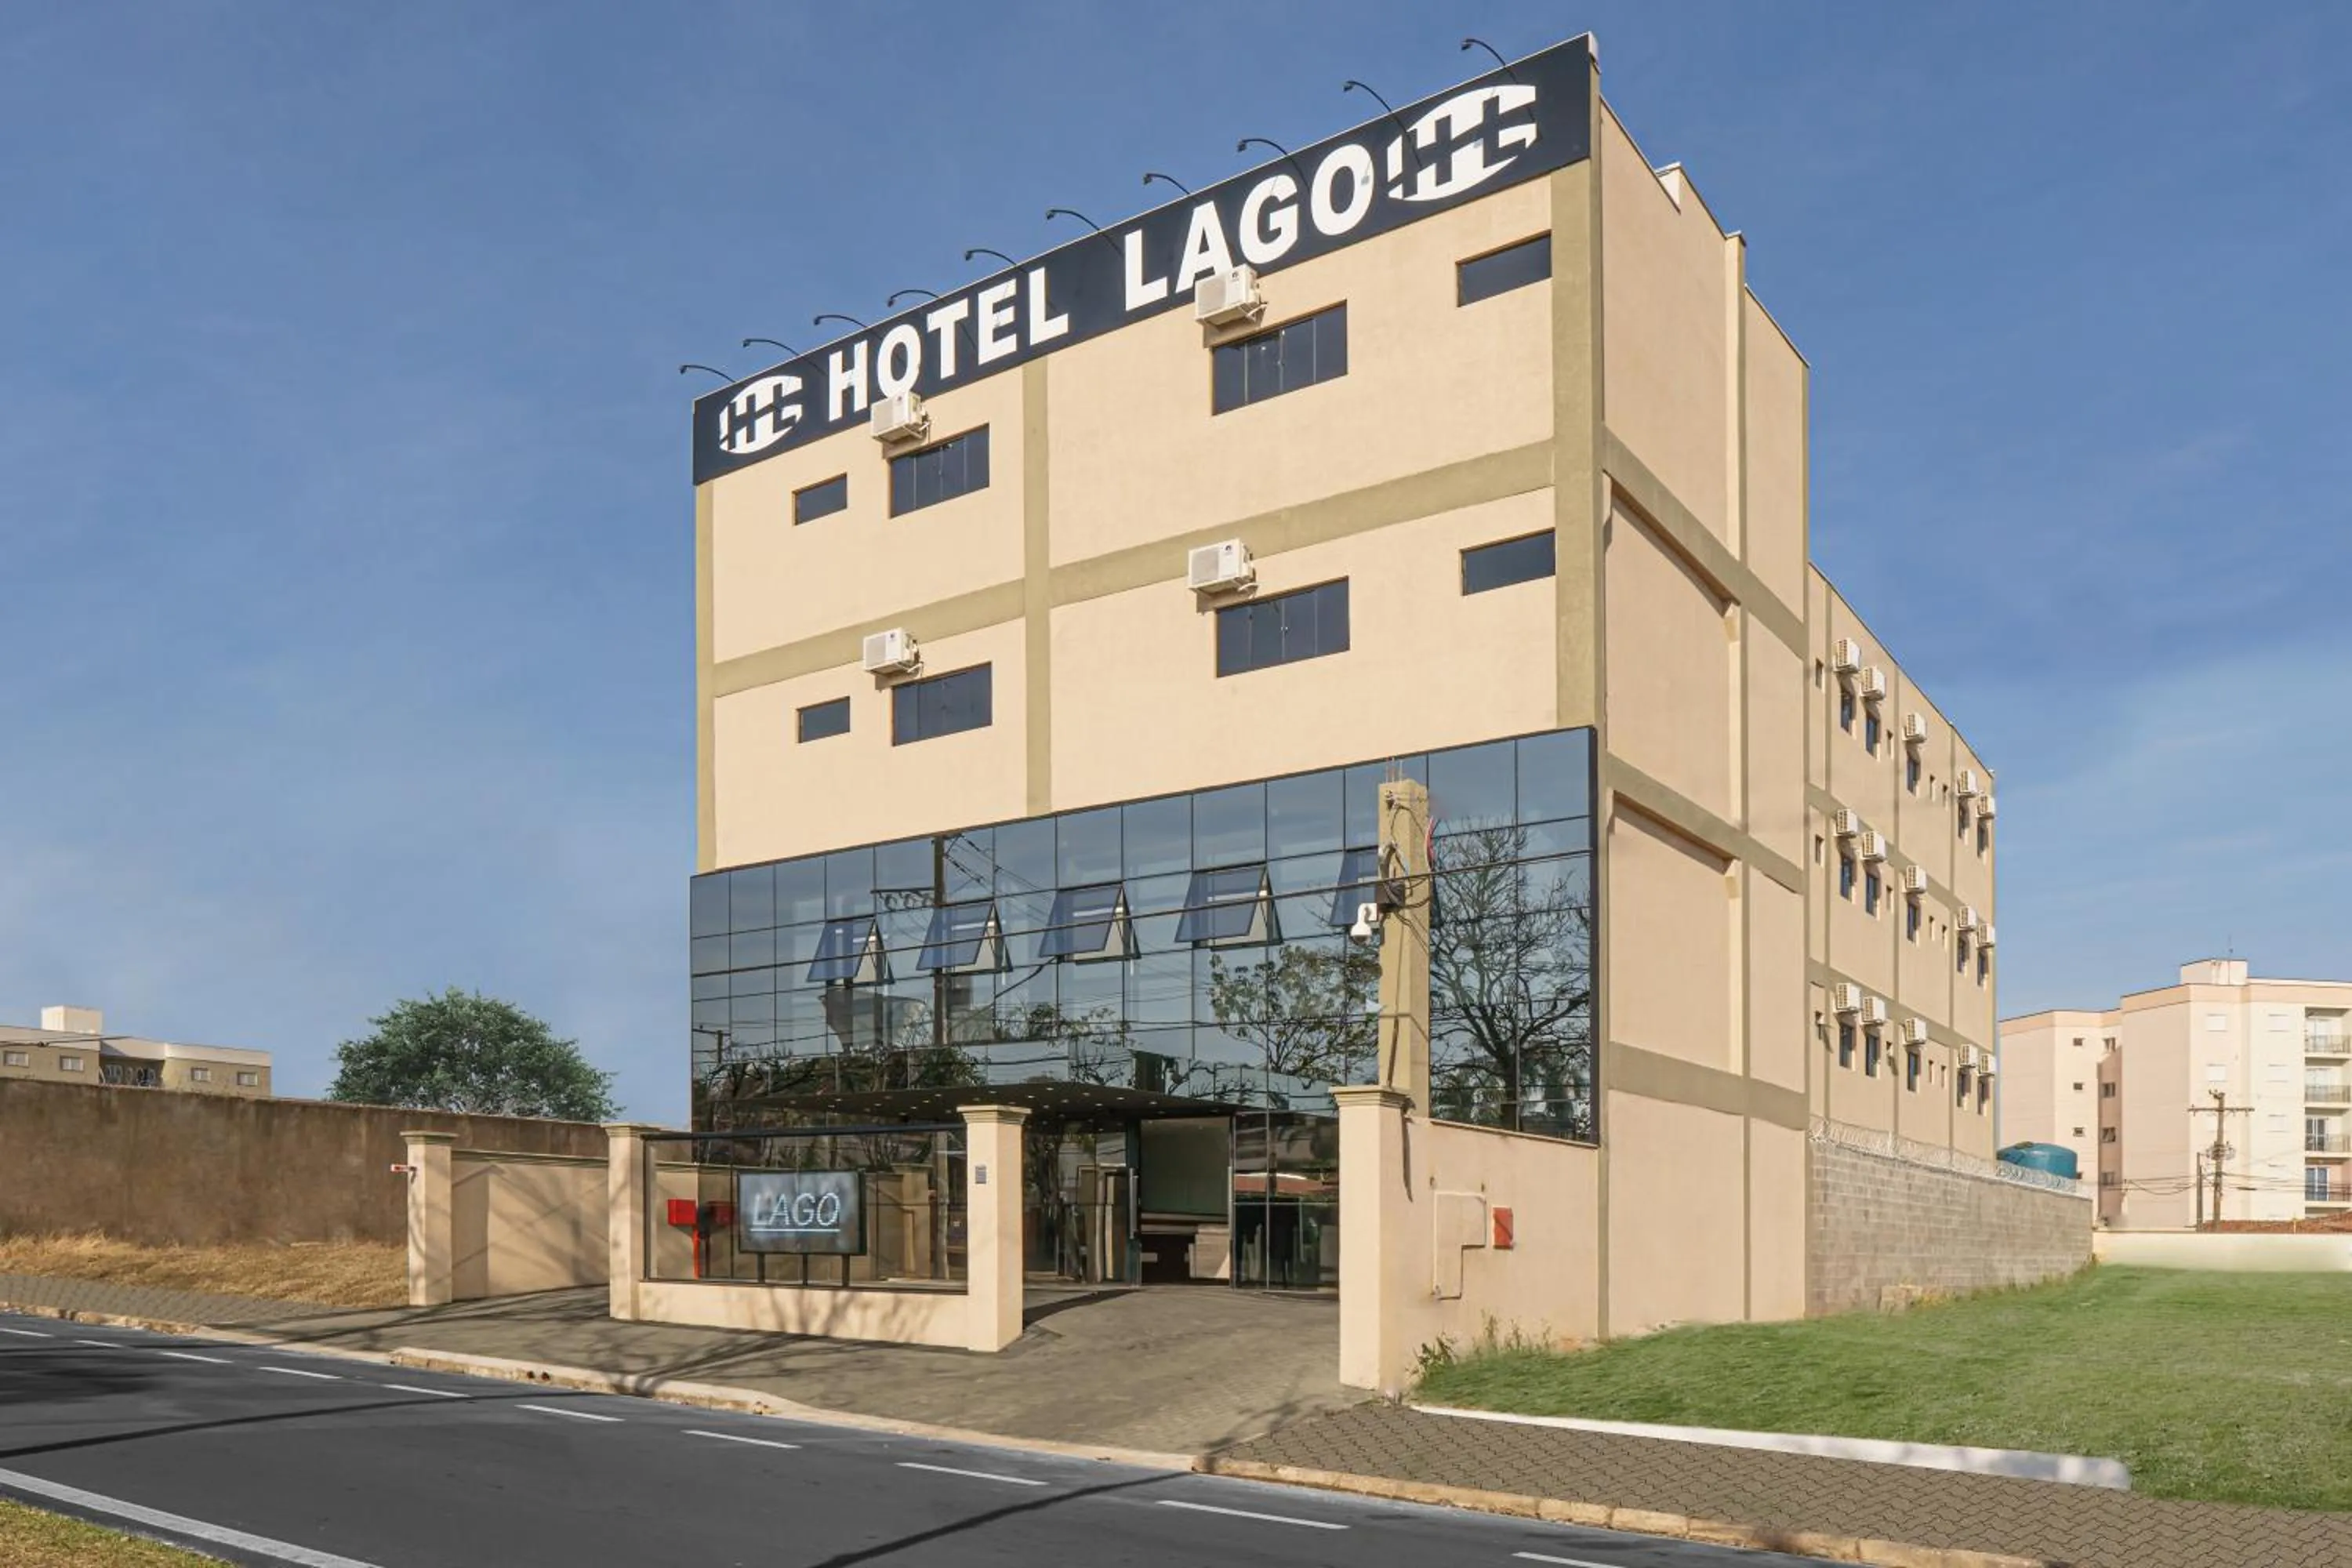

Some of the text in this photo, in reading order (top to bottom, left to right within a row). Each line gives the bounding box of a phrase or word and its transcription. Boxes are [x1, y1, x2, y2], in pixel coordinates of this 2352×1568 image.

[829, 143, 1374, 422] HOTEL LAGO
[752, 1192, 840, 1226] LAGO
